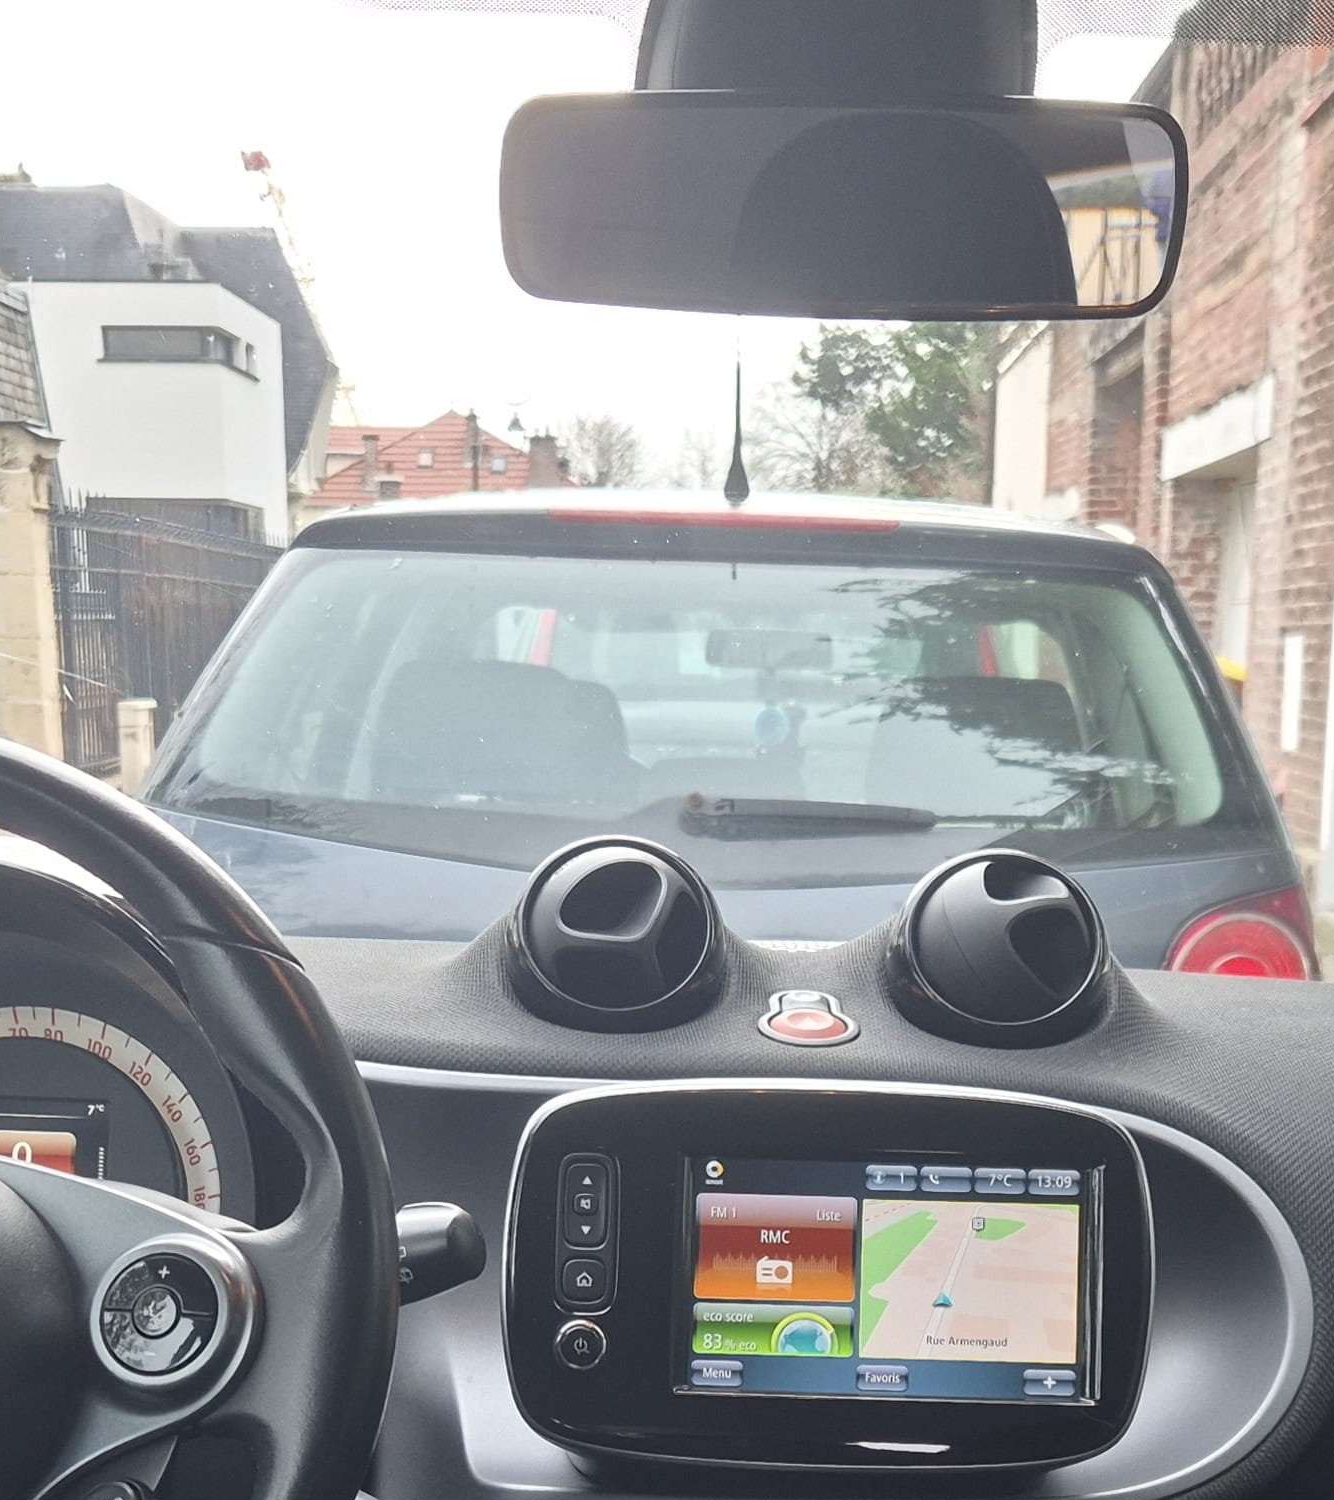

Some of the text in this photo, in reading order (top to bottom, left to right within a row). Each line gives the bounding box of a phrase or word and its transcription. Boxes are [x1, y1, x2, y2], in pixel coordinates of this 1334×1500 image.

[87, 1038, 113, 1060] 100
[129, 1061, 152, 1087] 120
[162, 1095, 183, 1123] 140
[184, 1138, 201, 1166] 160
[989, 1174, 1012, 1187] 7°C
[1037, 1175, 1072, 1189] 13:09
[711, 1207, 727, 1218] FM
[817, 1210, 842, 1222] Liste
[760, 1229, 791, 1244] RMC
[703, 1312, 754, 1323] eco score
[703, 1333, 722, 1350] 83
[739, 1342, 757, 1351] eco
[926, 1336, 1008, 1348] Rue Armengaud
[702, 1367, 732, 1379] Menu
[865, 1372, 901, 1385] Favoris
